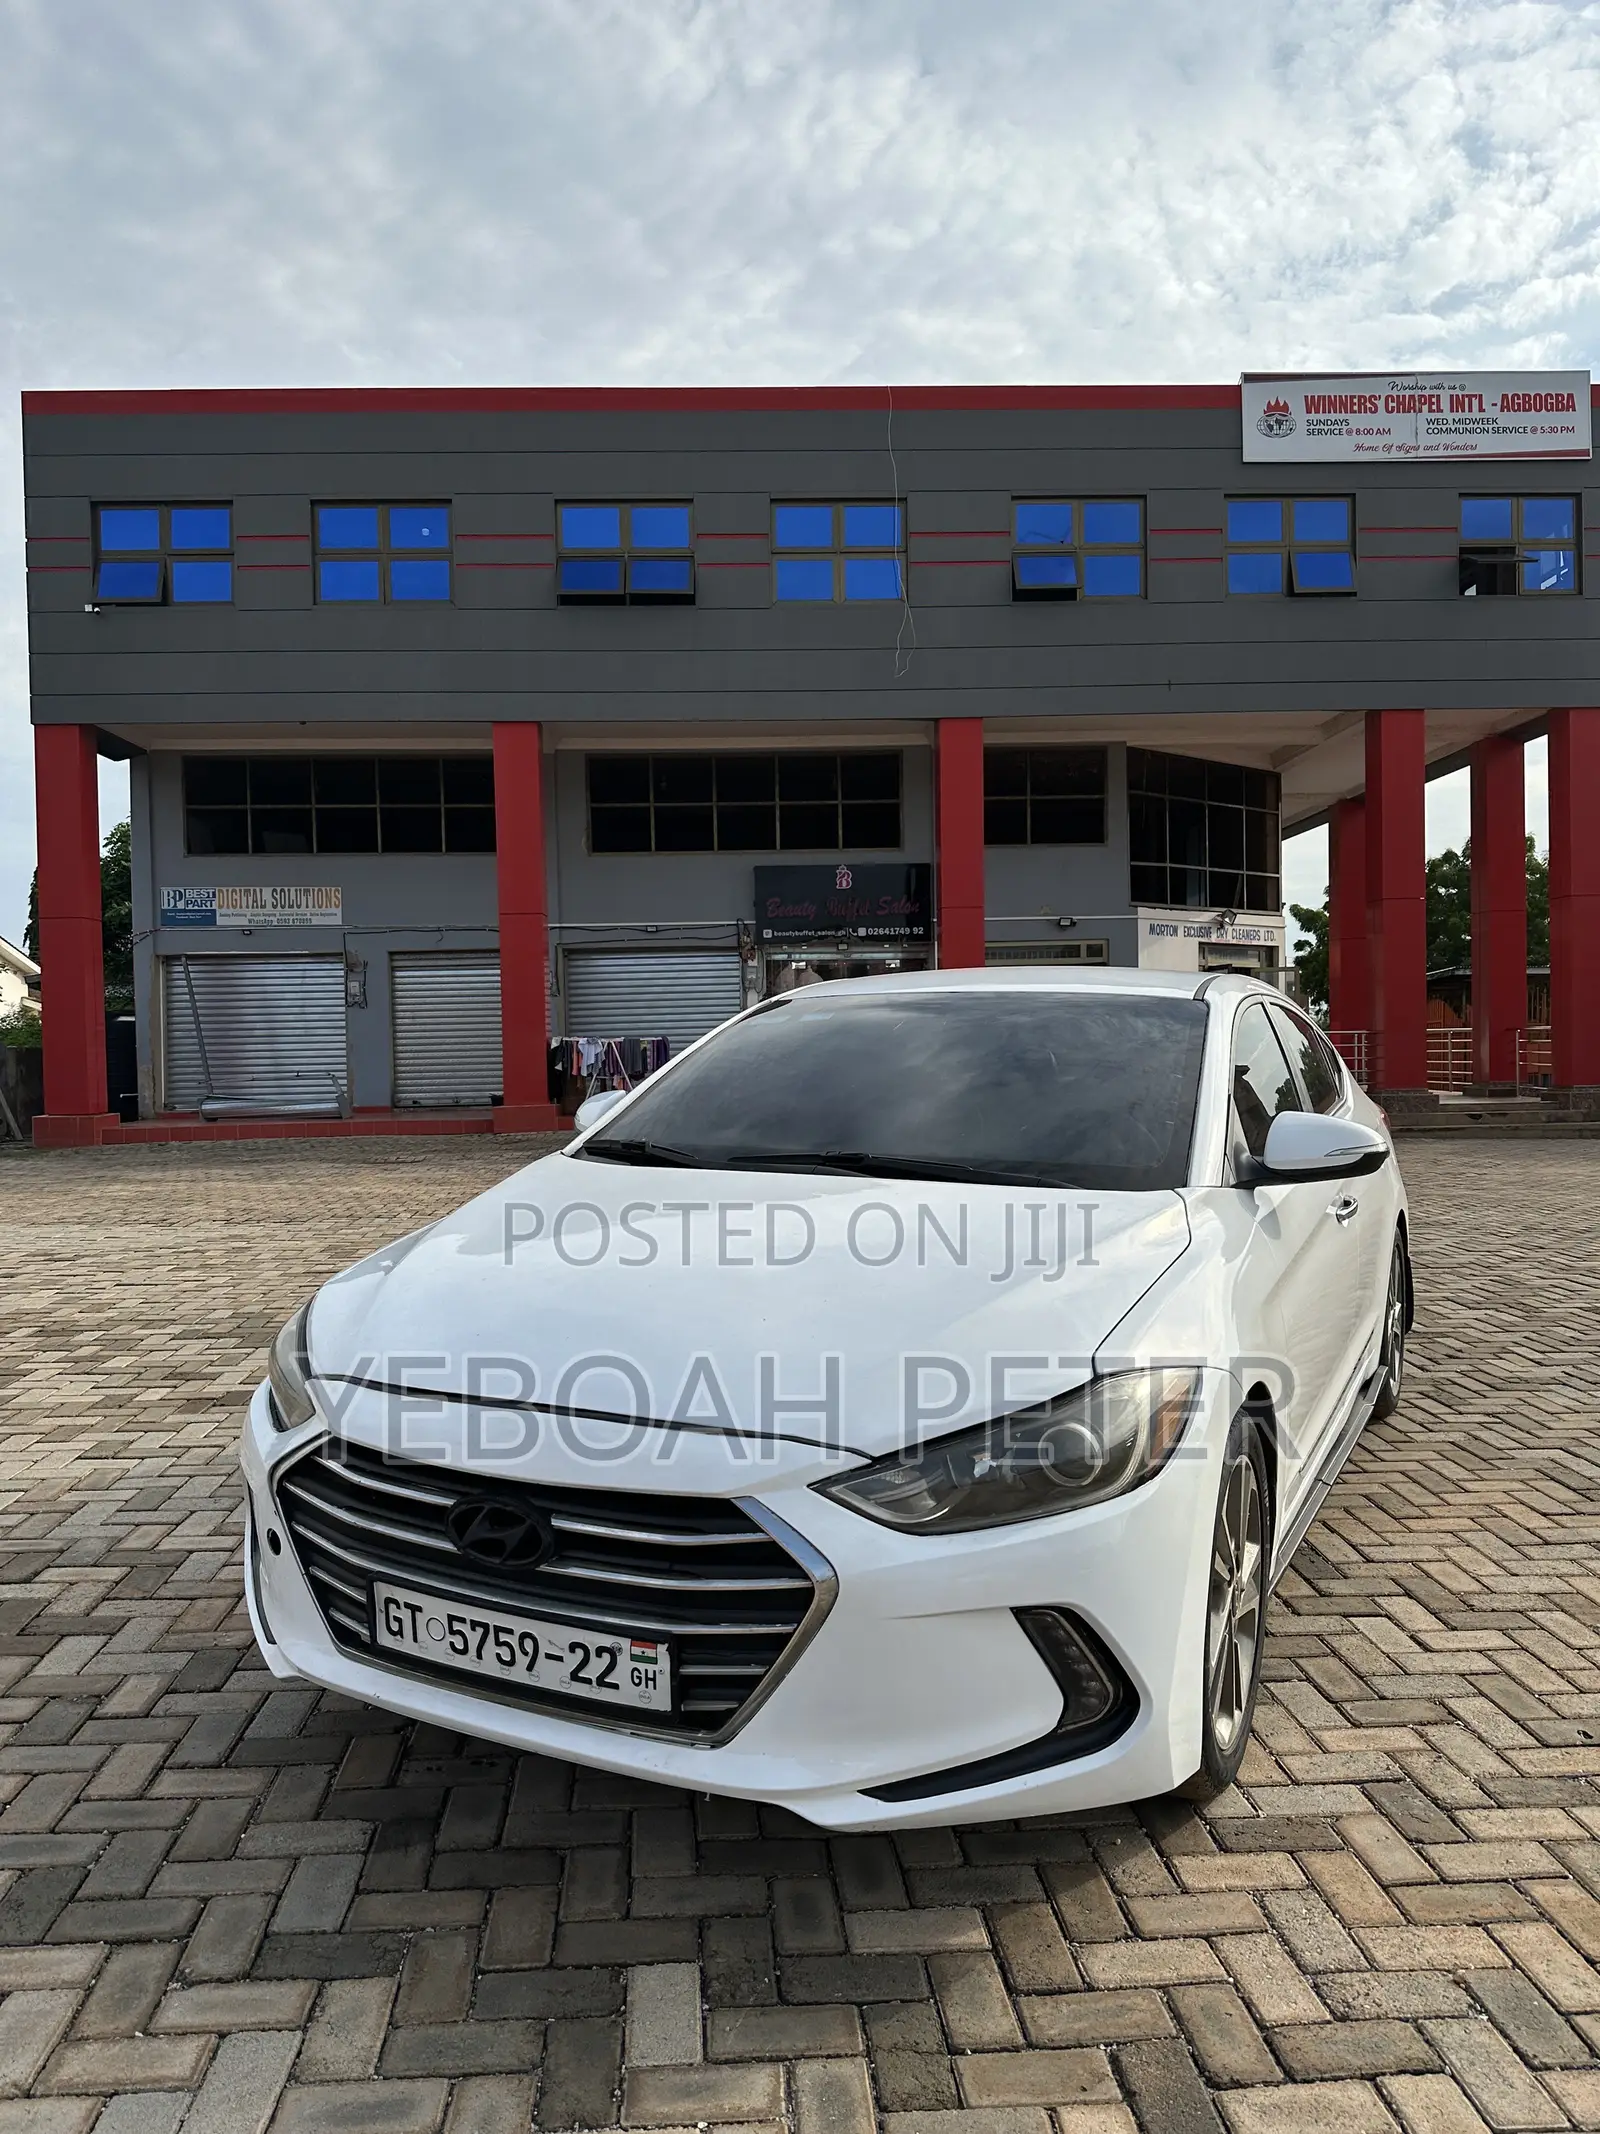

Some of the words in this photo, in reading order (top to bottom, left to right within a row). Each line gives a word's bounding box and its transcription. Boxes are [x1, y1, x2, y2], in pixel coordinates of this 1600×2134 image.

[1388, 381, 1427, 392] Worship
[1429, 382, 1446, 391] with
[1304, 394, 1381, 414] WINNERS'
[1384, 394, 1443, 414] CHAPEL
[1450, 394, 1485, 413] INT'L
[1500, 393, 1576, 413] AGBOGBA
[1306, 418, 1350, 427] SUNDAYS
[1426, 418, 1450, 426] WED.
[1452, 417, 1499, 425] MIDWEEK
[1306, 428, 1344, 436] SERVICE
[1345, 428, 1354, 436] @
[1355, 427, 1375, 436] 8:00
[1375, 427, 1391, 436] AM
[1426, 426, 1489, 435] COMMUNION
[1491, 426, 1528, 434] SERVICE
[1529, 425, 1538, 434] @
[1540, 425, 1559, 434] 5:30
[1560, 425, 1575, 433] PM
[1353, 442, 1379, 452] Home
[1382, 442, 1394, 454] Of
[1395, 443, 1421, 454] Signs
[1423, 442, 1441, 451] and
[1442, 441, 1478, 451] Wonders
[186, 889, 215, 898] BEST
[217, 888, 267, 909] DIGITAL
[271, 887, 341, 909] SOLUTIONS
[186, 899, 215, 908] PART
[766, 897, 817, 921] Beauty
[876, 895, 920, 916] Salon
[867, 927, 910, 936] 02641749
[913, 926, 924, 935] 92
[1149, 923, 1178, 937] MORTON
[1183, 925, 1212, 939] EXCLUSIVE
[1216, 927, 1229, 940] DRY
[1232, 928, 1261, 941] CLEANERS
[1263, 930, 1276, 942] LTD.
[383, 1596, 423, 1644] GT
[447, 1612, 620, 1691] 5759-22
[630, 1666, 657, 1691] GH
